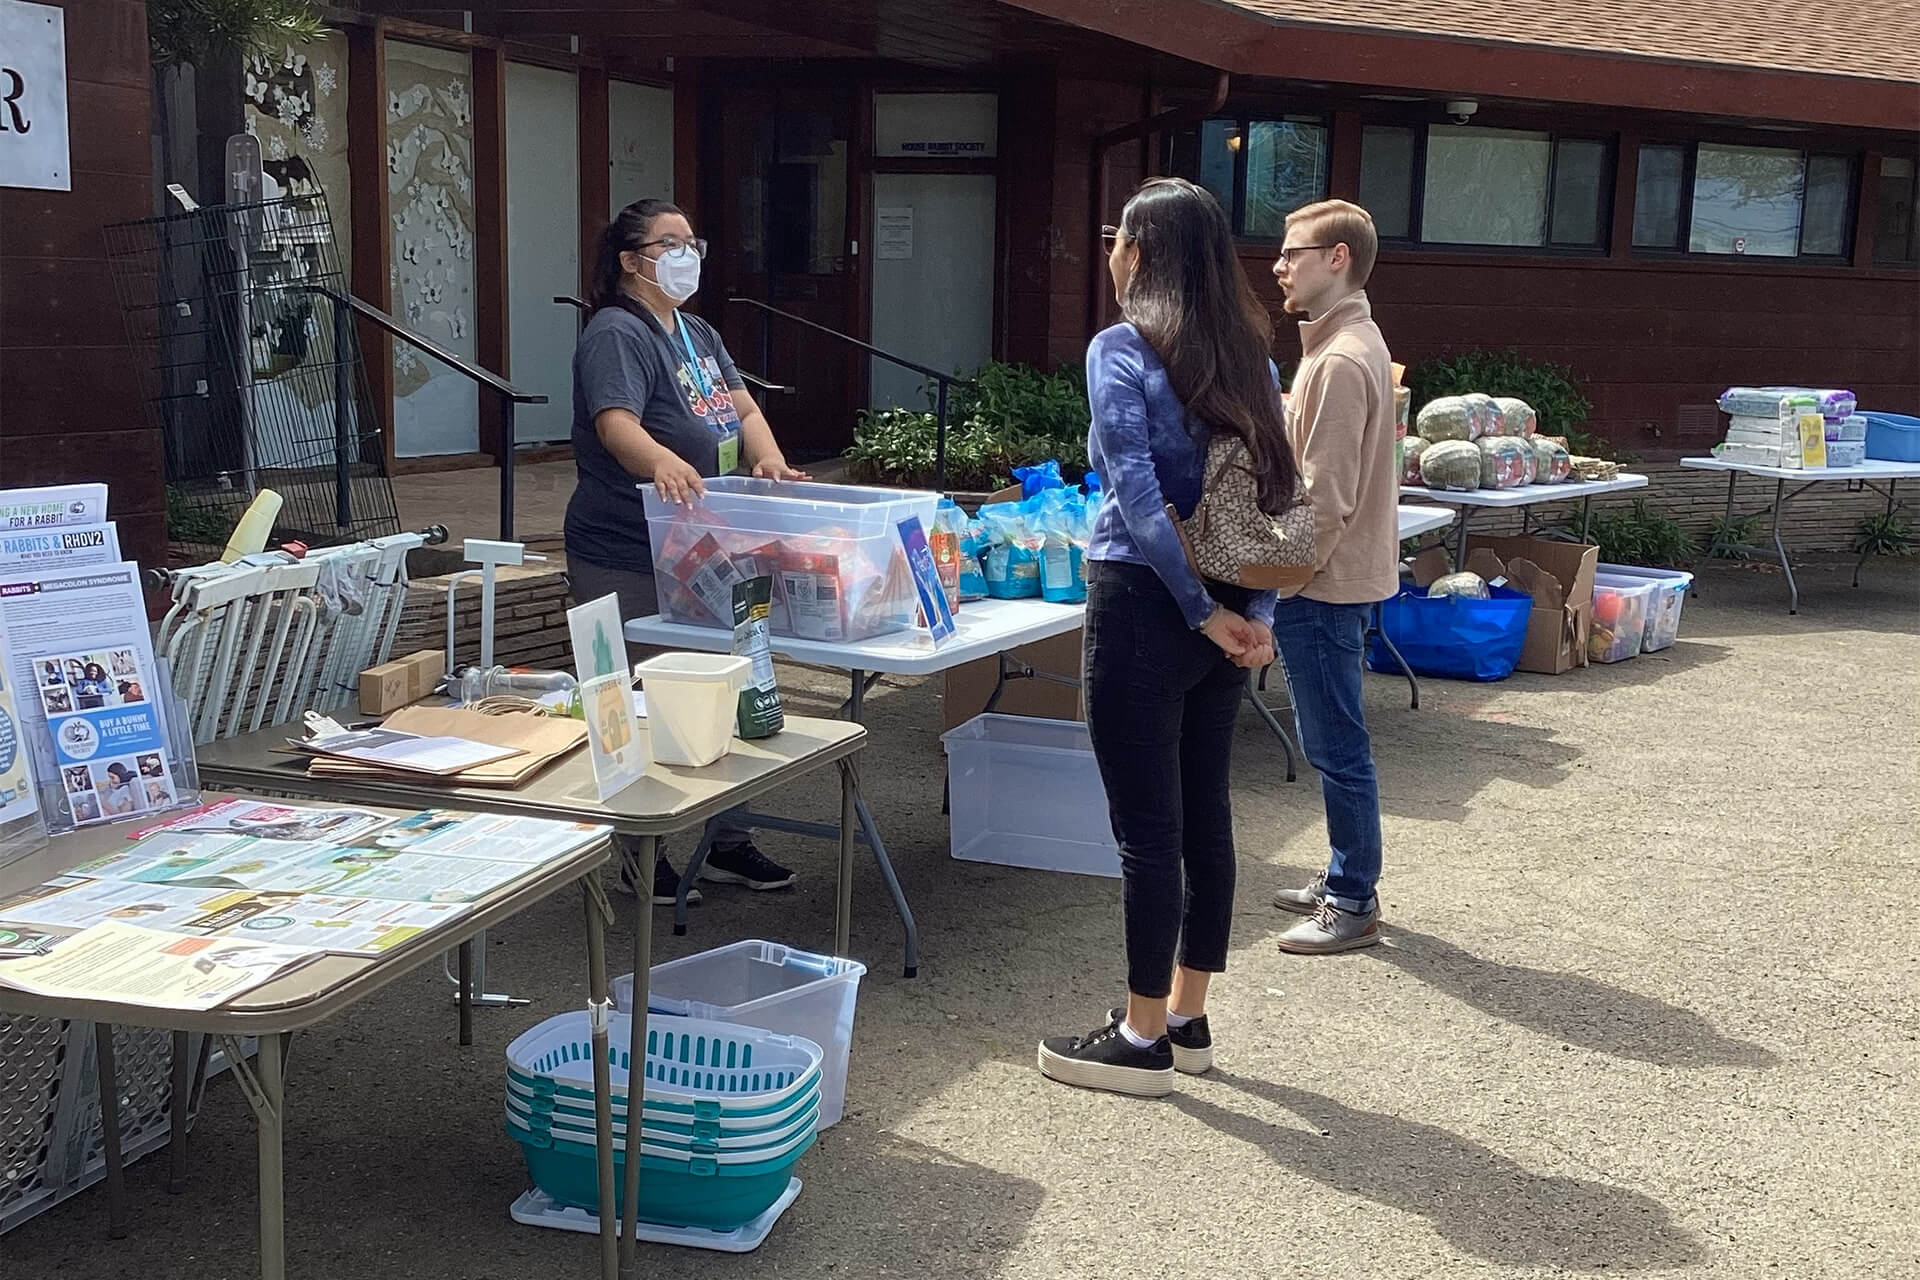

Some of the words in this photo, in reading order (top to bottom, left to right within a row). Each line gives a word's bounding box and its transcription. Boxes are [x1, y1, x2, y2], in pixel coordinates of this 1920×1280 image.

[13, 506, 18, 516] A
[20, 505, 40, 515] NEW
[41, 503, 64, 514] HOME
[9, 516, 25, 528] FOR
[27, 515, 32, 526] A
[34, 513, 63, 525] RABBIT
[4, 536, 49, 553] RABBITS
[53, 535, 61, 549] &
[64, 532, 103, 548] RHDV2
[1, 585, 31, 595] RABBITS
[42, 578, 87, 591] MEGACOLON
[88, 574, 128, 586] SYNDROME
[99, 718, 114, 728] BUY
[115, 717, 121, 726] A
[121, 713, 147, 725] BUNNY
[108, 725, 135, 736] LITTLE
[133, 721, 151, 732] TIME
